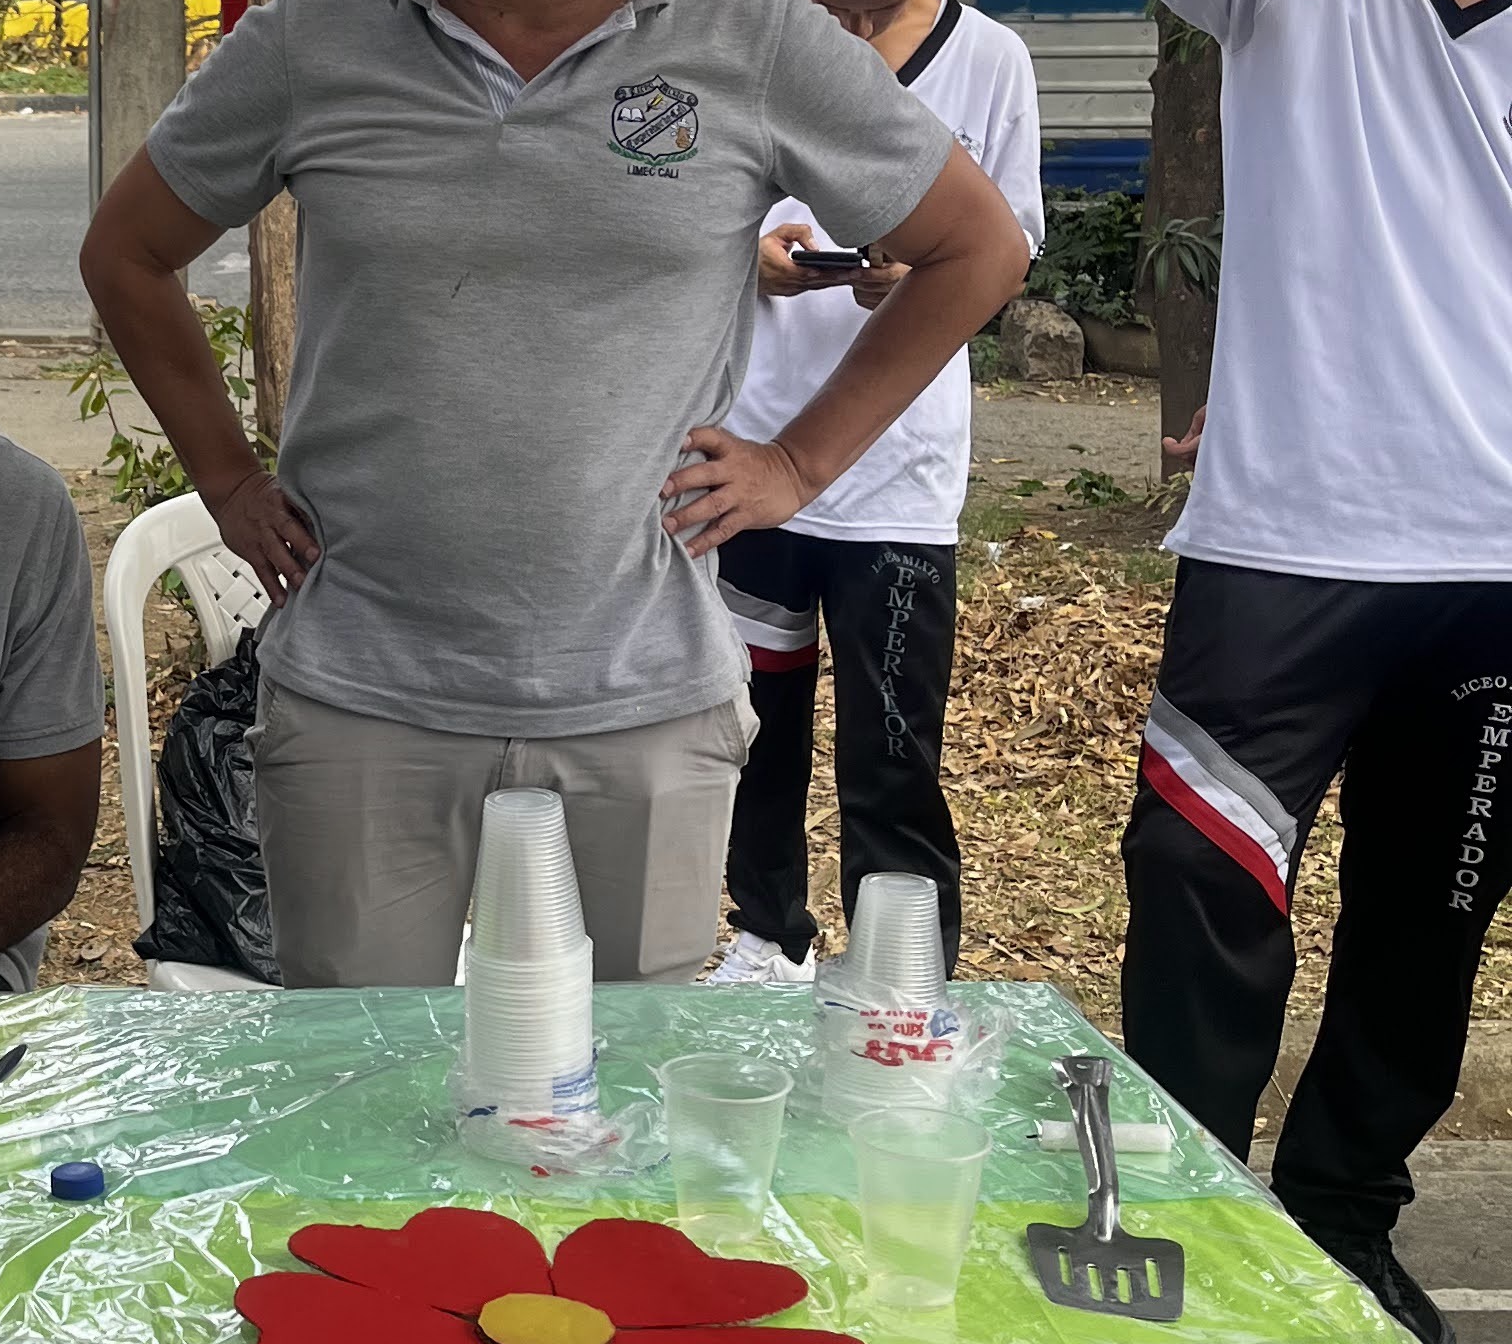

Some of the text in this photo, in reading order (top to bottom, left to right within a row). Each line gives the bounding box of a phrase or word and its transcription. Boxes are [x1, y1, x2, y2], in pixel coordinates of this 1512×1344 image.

[658, 167, 680, 179] CALI
[1451, 675, 1508, 701] LICEO
[1448, 703, 1512, 912] EMPERADOR
